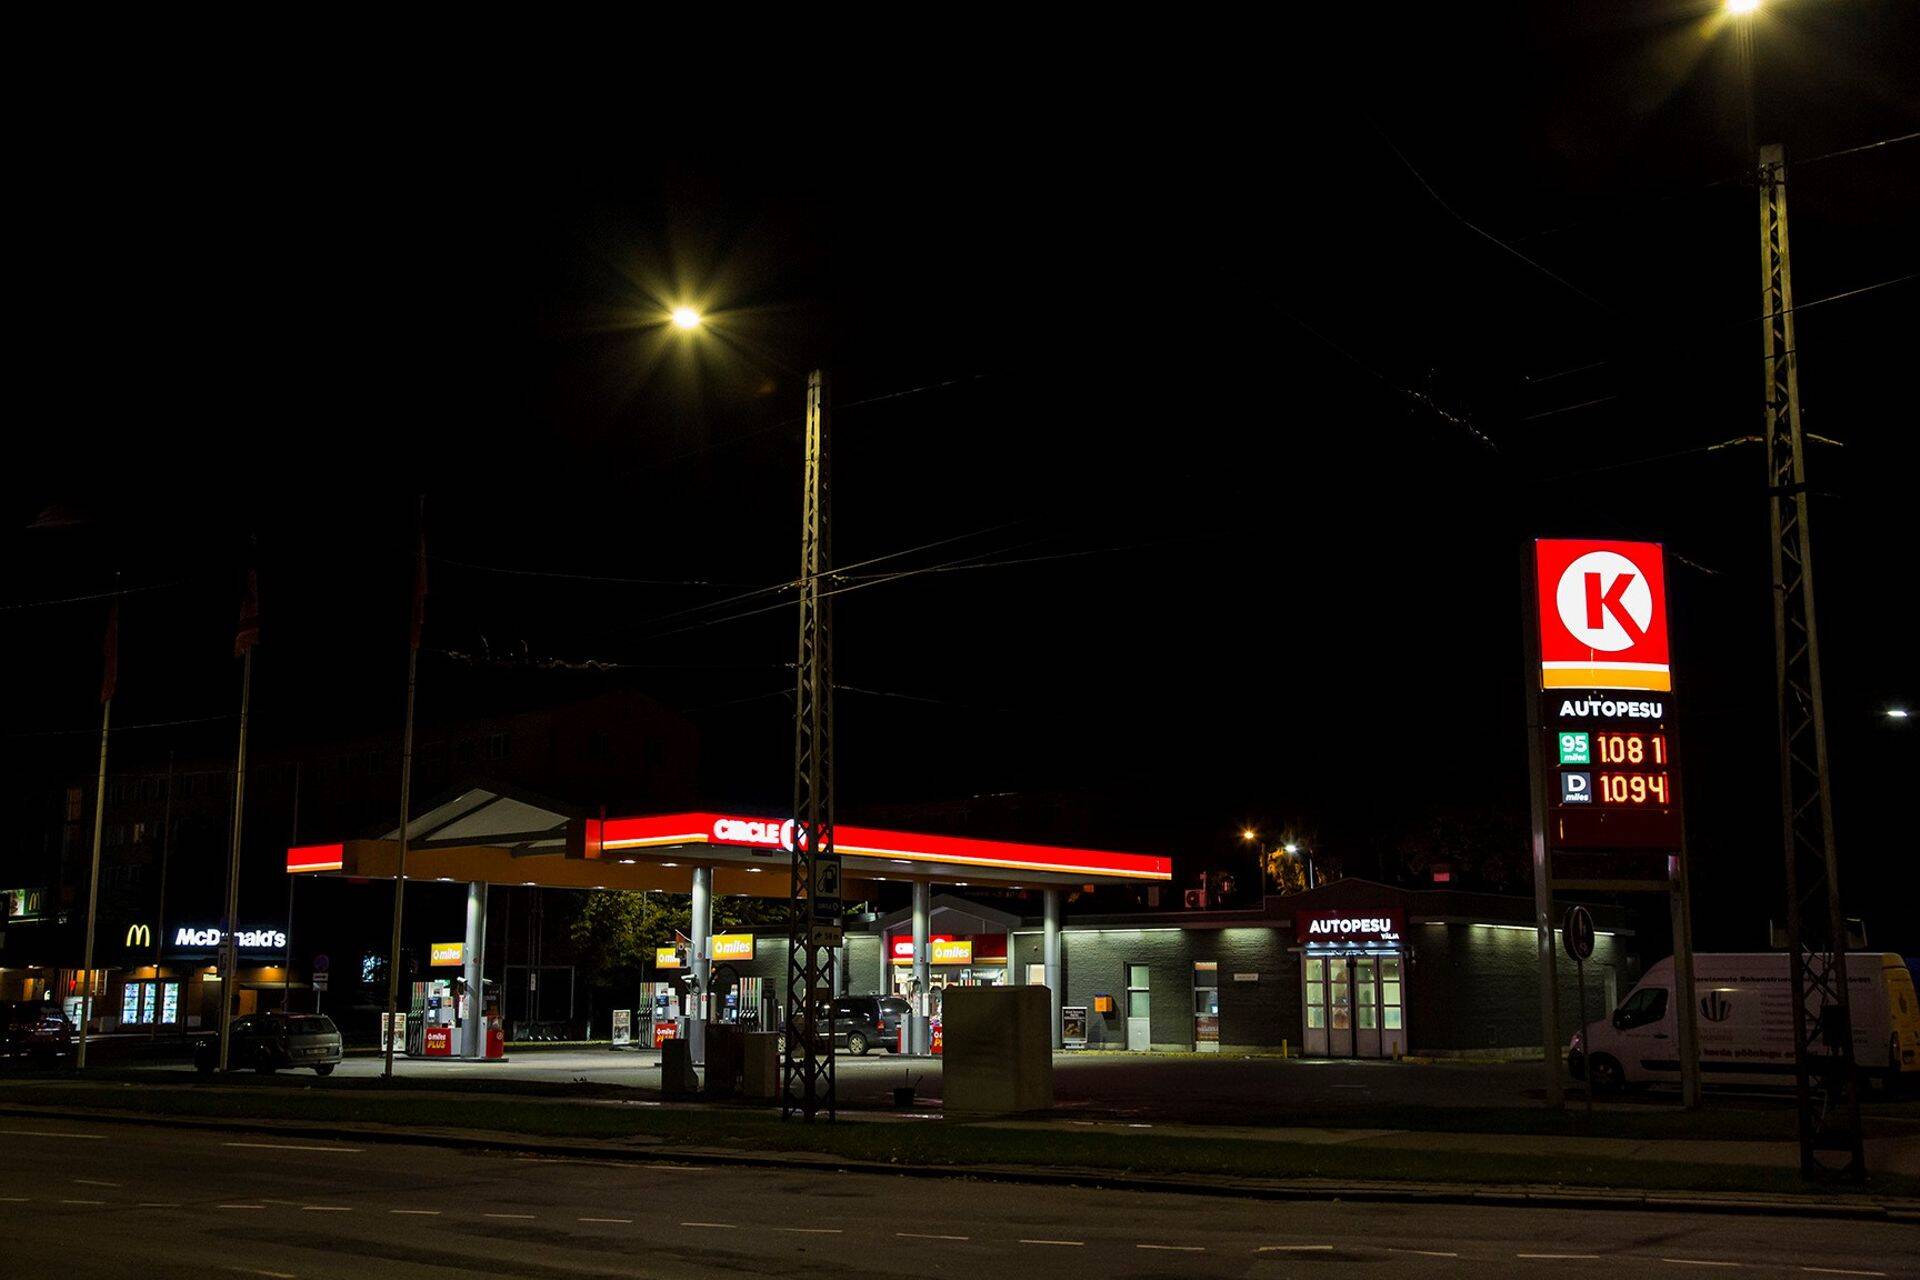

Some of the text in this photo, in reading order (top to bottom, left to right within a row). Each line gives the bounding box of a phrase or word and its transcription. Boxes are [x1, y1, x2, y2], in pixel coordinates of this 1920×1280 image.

[1560, 700, 1662, 718] AUTOPESU
[1562, 735, 1587, 753] 95
[1567, 774, 1664, 803] D 1.094
[1309, 919, 1391, 933] AUTOPESU
[175, 928, 286, 948] McDnald's
[428, 1040, 446, 1049] PLUS
